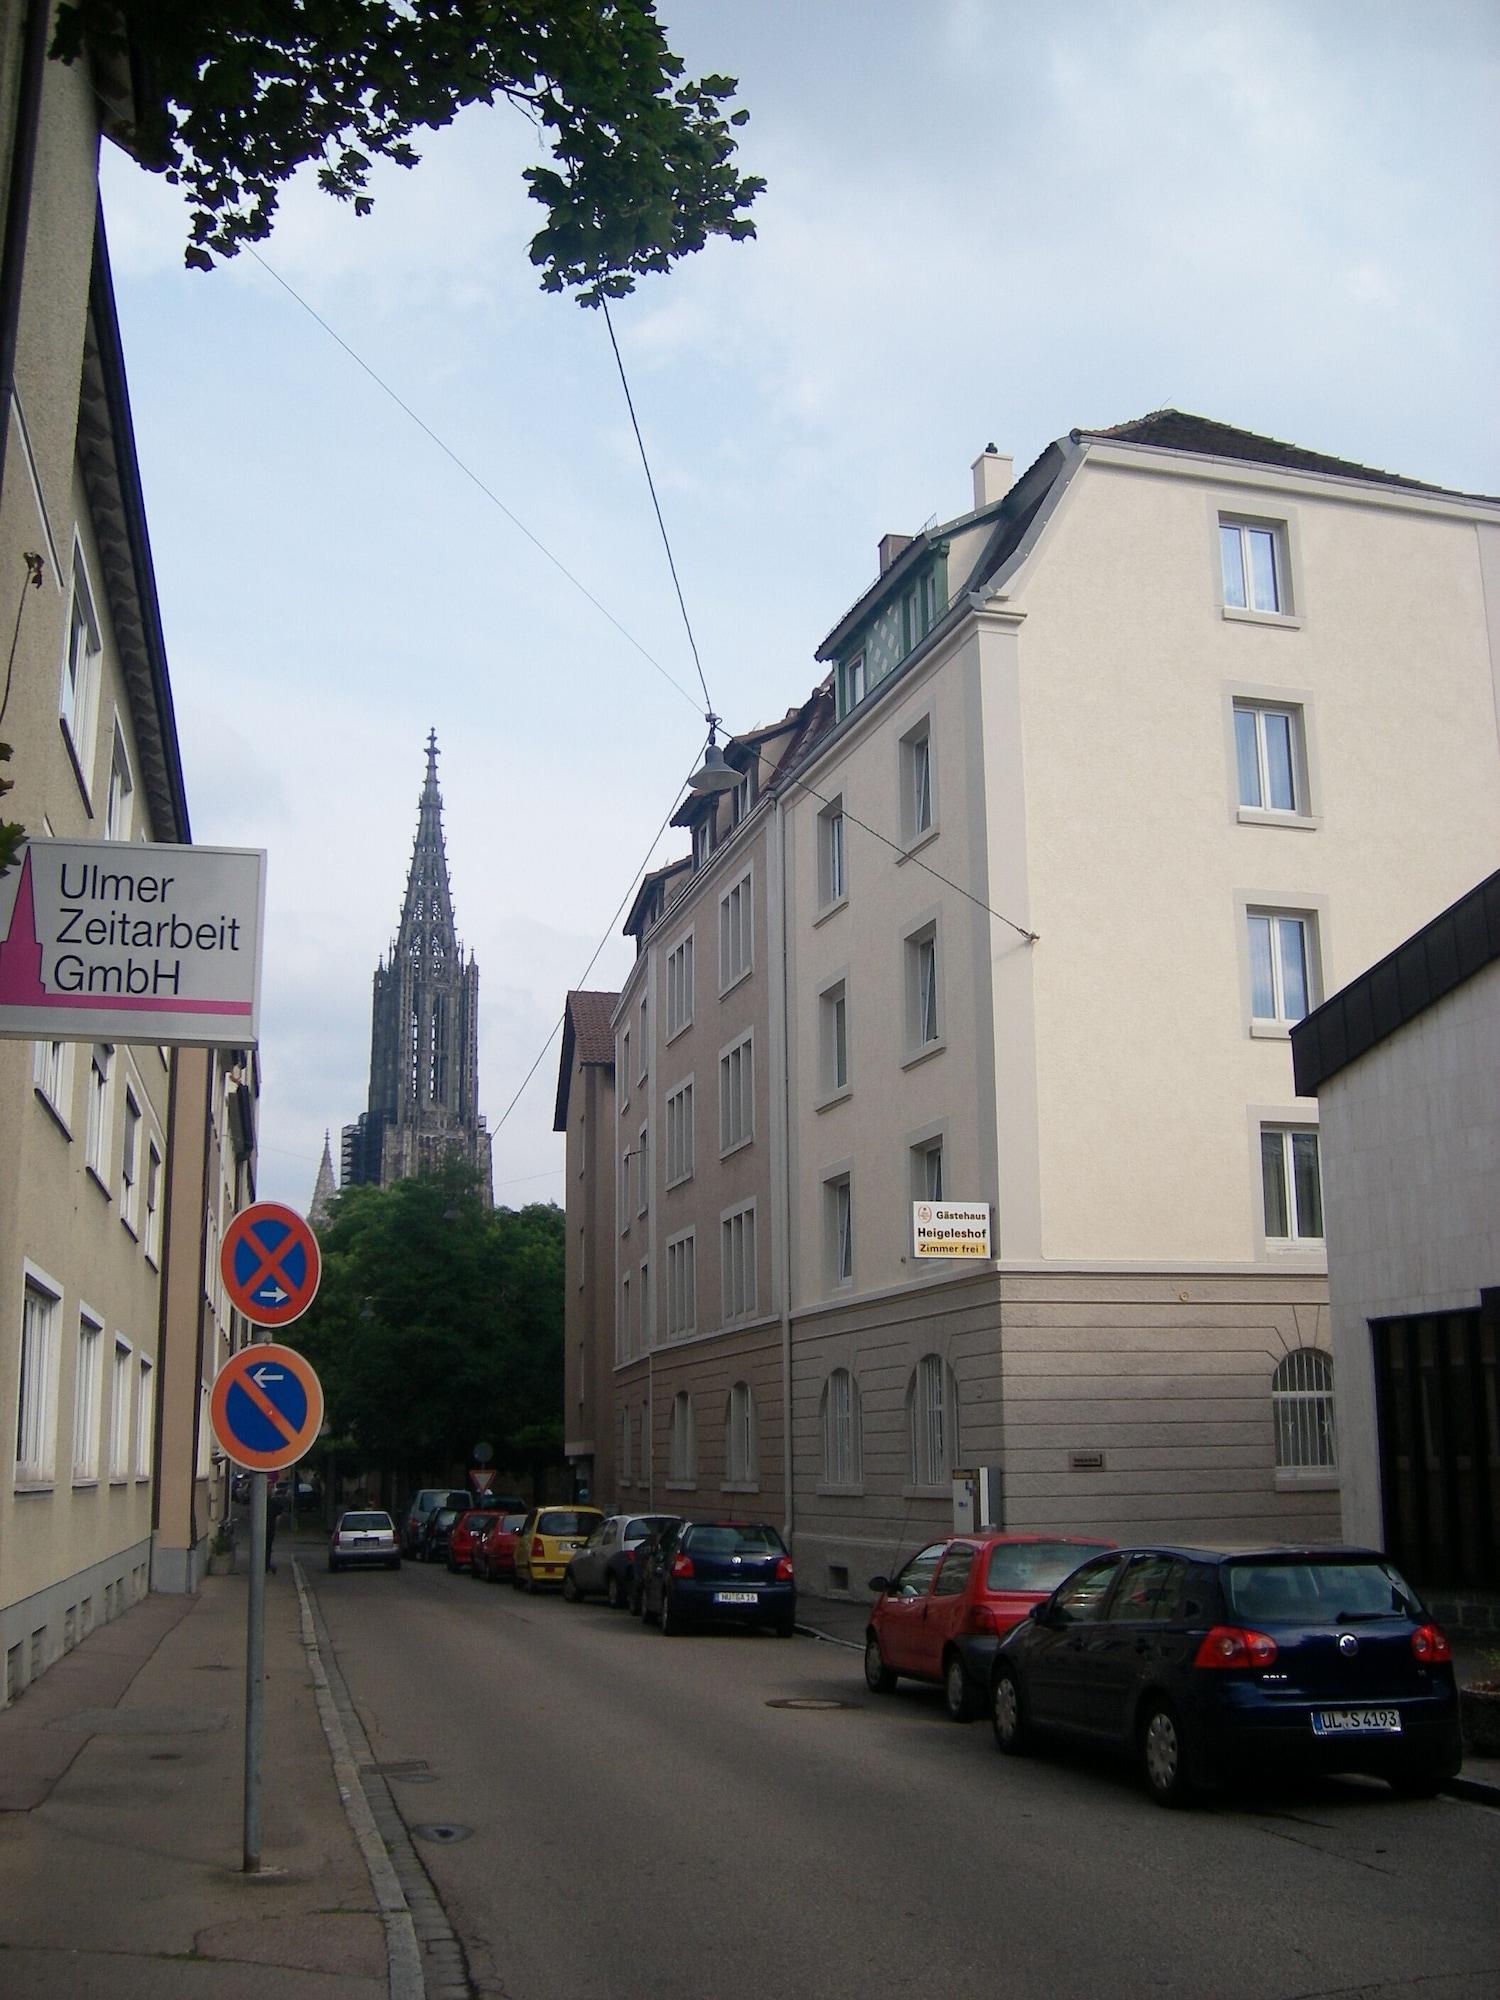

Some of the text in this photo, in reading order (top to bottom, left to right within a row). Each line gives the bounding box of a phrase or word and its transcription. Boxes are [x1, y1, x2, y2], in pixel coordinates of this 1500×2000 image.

[60, 863, 174, 903] Ulmer
[56, 908, 240, 951] Zeitarbeit
[54, 954, 180, 995] GmbH
[936, 1211, 986, 1220] Gästehaus
[918, 1227, 987, 1239] Heigeleshof
[920, 1244, 958, 1253] Zimmer
[962, 1245, 979, 1253] frei
